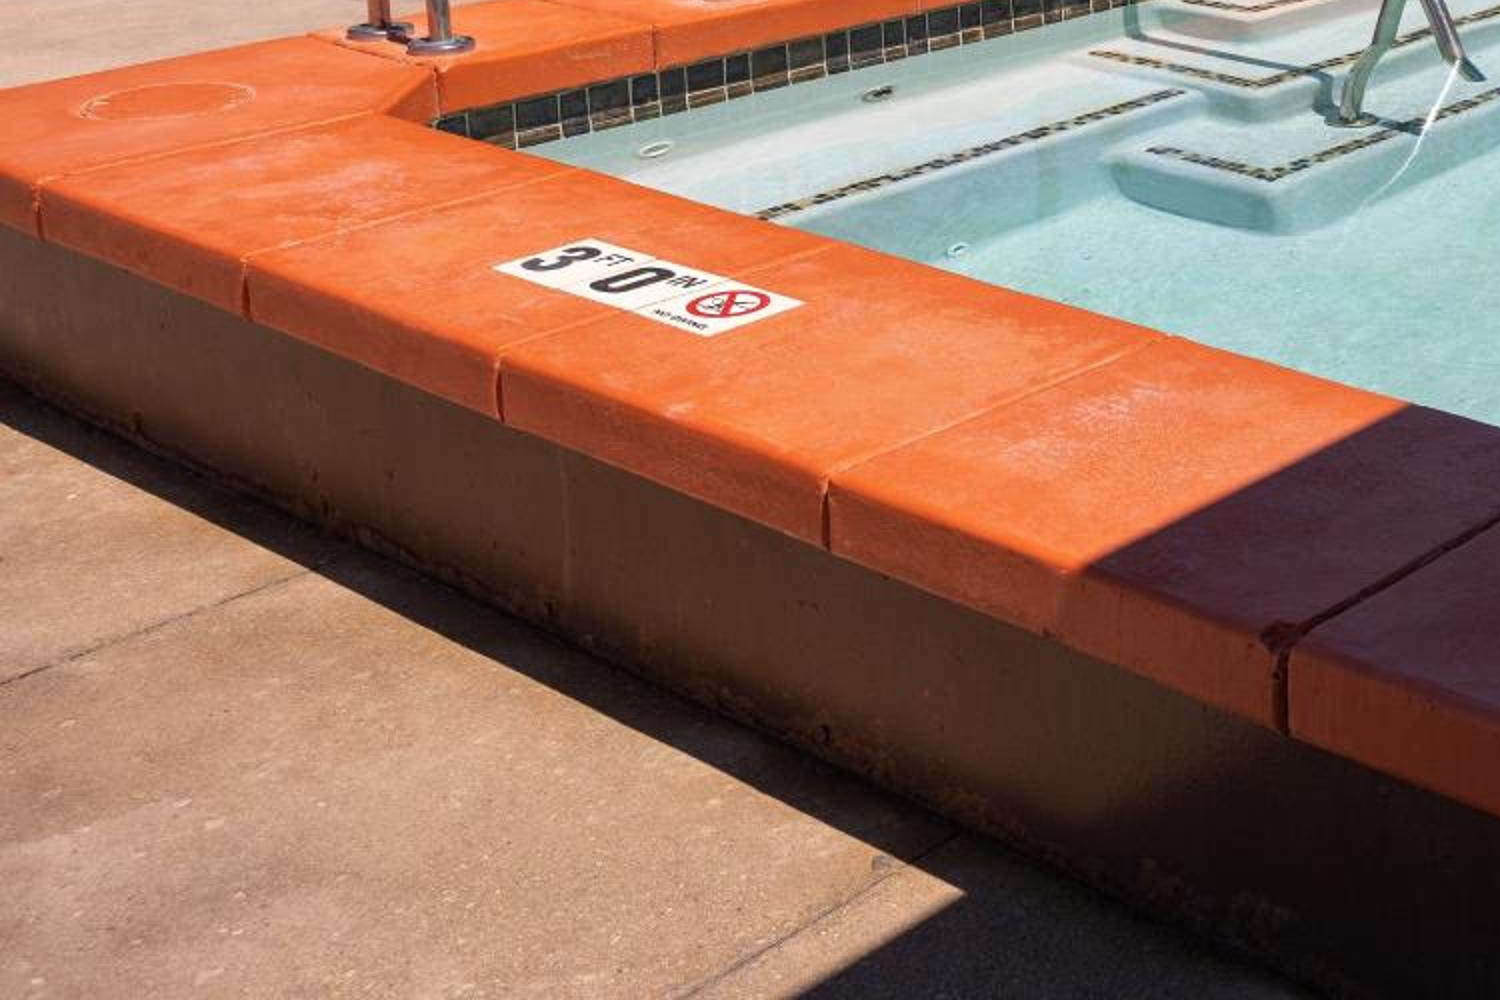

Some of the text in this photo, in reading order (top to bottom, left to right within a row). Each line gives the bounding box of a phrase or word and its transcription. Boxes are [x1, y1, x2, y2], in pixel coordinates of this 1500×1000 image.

[520, 246, 602, 272] 3
[593, 253, 635, 267] FT
[589, 266, 676, 293] 0
